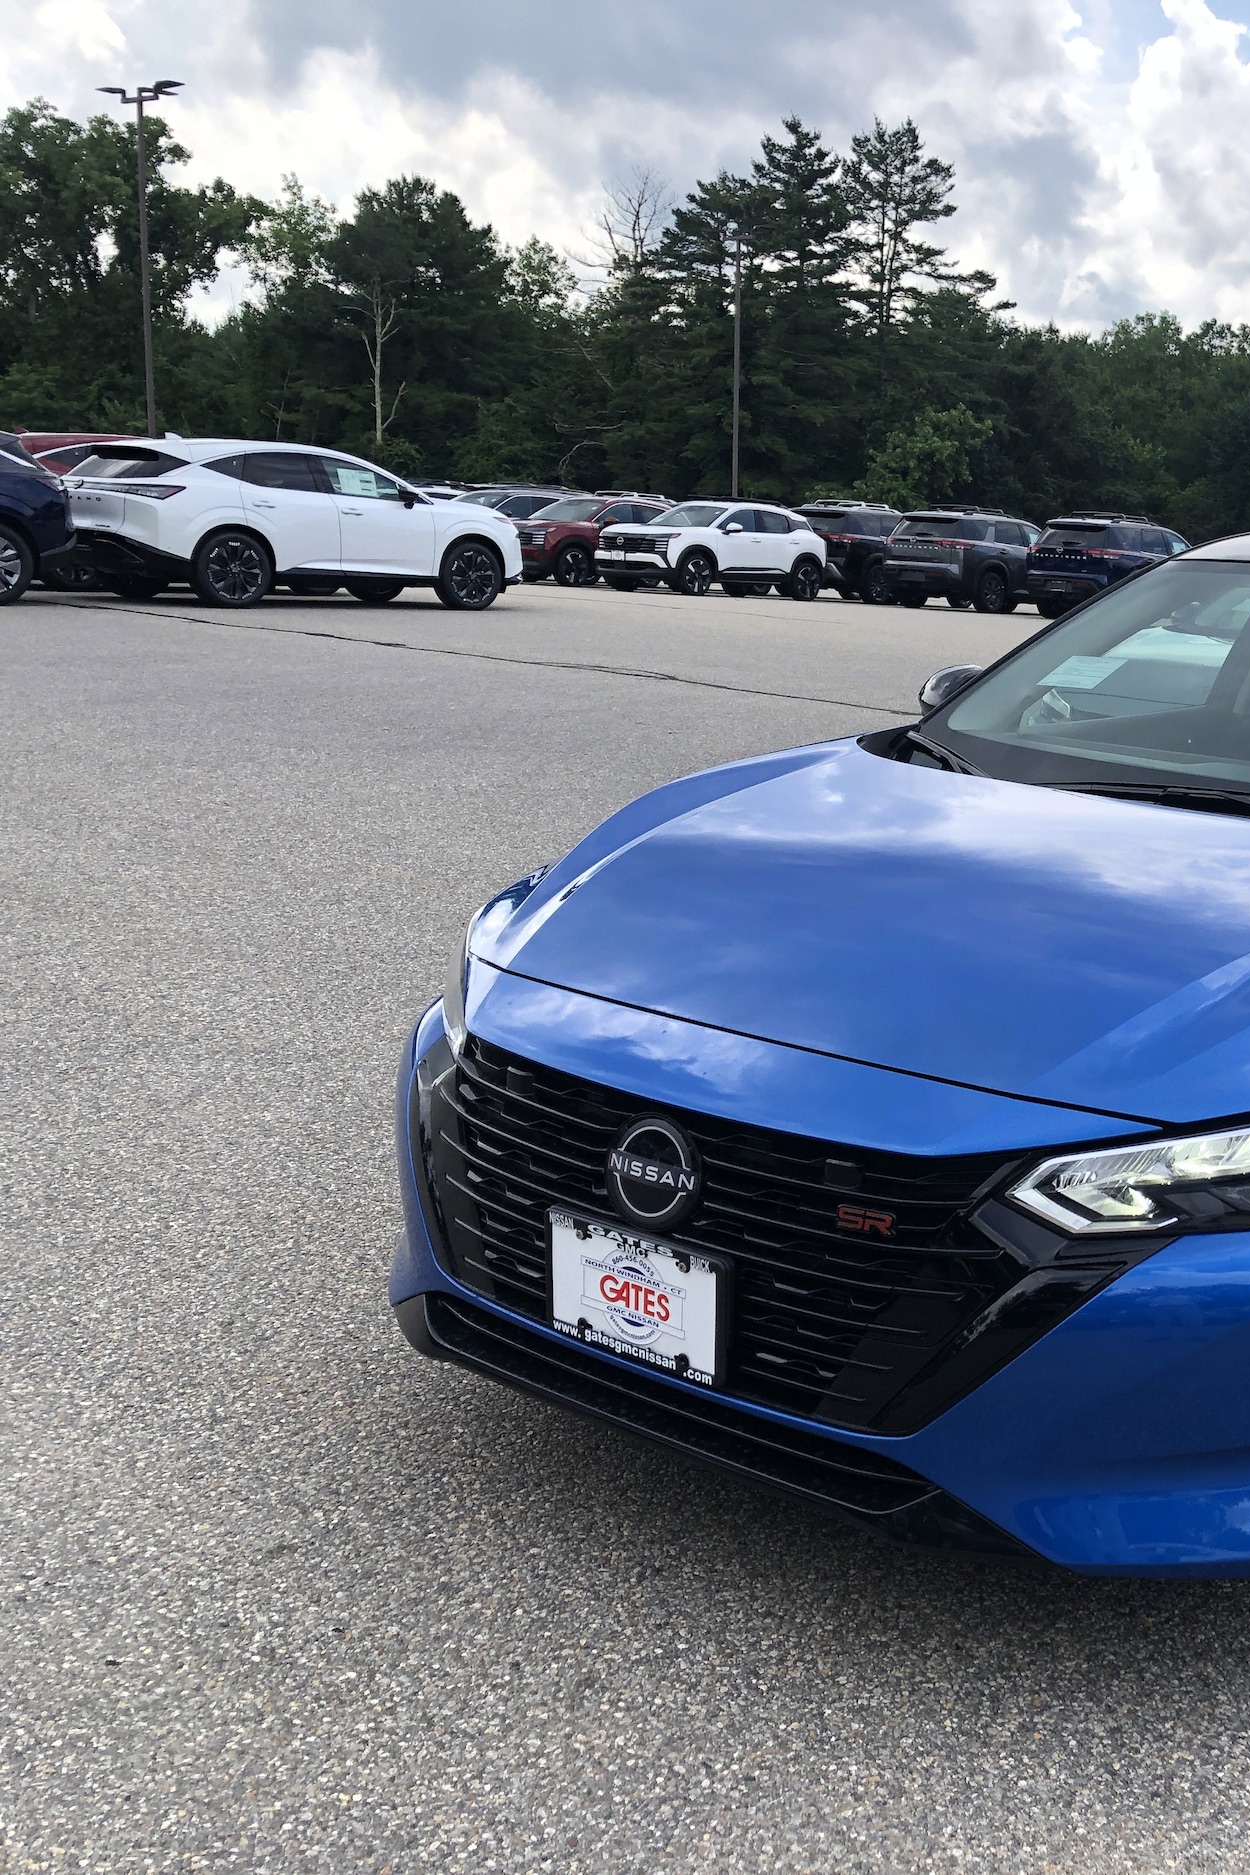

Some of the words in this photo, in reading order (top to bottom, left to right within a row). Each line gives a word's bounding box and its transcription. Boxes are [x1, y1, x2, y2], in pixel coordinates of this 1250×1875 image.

[609, 1152, 695, 1191] NISSAN
[549, 1212, 575, 1230] NISSAN
[837, 1206, 893, 1235] SR
[587, 1224, 674, 1257] GATES
[616, 1242, 646, 1258] GMC
[584, 1259, 615, 1273] NORTH
[616, 1269, 660, 1288] WINDHAM
[689, 1255, 710, 1273] BUICK
[599, 1274, 670, 1322] GATES
[606, 1305, 627, 1317] GMC
[628, 1312, 660, 1328] NISSAN
[553, 1319, 582, 1339] www.
[584, 1327, 677, 1371] gatesgmcnissan
[682, 1368, 713, 1386] .com
